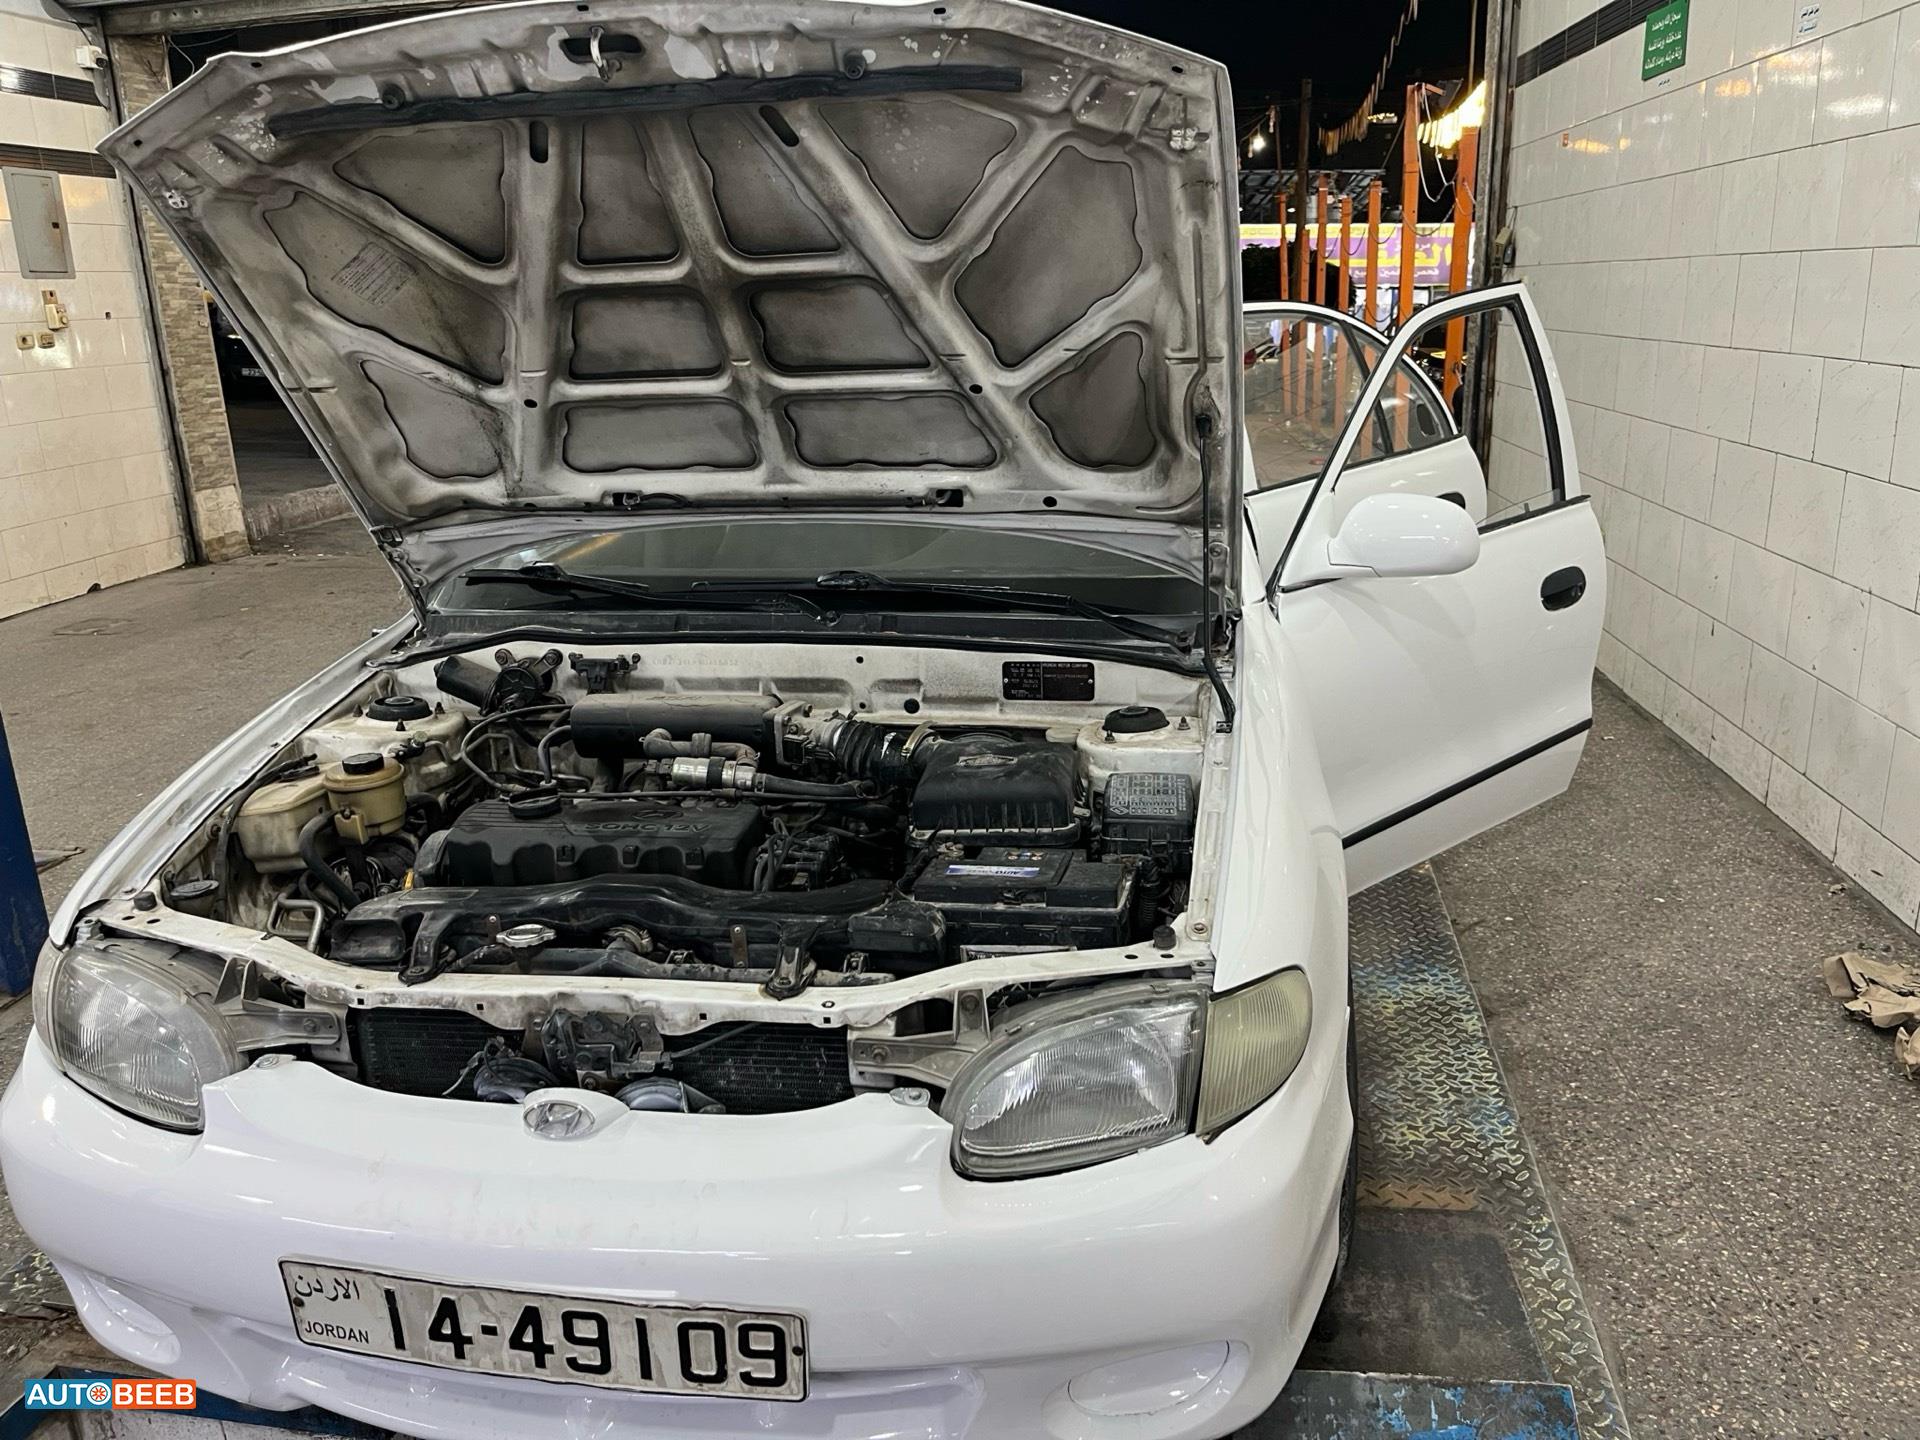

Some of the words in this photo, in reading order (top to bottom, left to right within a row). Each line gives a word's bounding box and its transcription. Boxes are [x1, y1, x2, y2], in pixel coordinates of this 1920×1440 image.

[584, 823, 659, 832] SOHC
[663, 823, 711, 833] 12V
[294, 1275, 360, 1302] الاردن
[305, 1321, 369, 1344] JORDAN
[384, 1287, 787, 1388] 14-49109
